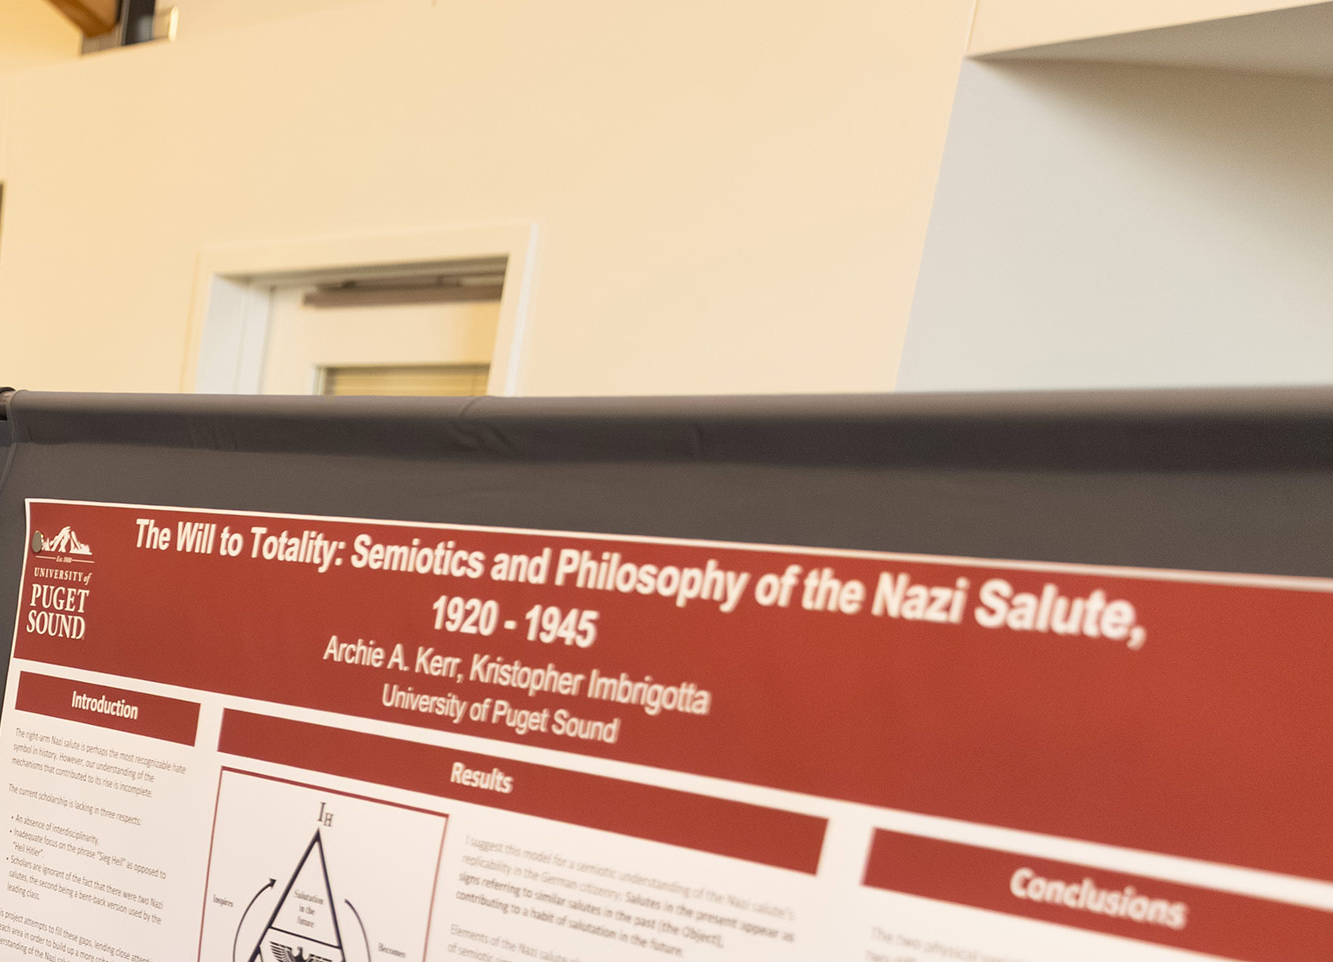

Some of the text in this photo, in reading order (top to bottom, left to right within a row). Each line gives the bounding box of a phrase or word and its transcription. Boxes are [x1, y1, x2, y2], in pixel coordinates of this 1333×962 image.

[34, 567, 92, 585] UNIVERSITY of
[135, 518, 1147, 652] The Will to Totality: Semiotics and Philosophy of the Nazi Salute,
[30, 584, 89, 613] PUGET
[26, 610, 85, 640] SOUND
[433, 595, 500, 637] 1920
[525, 603, 600, 648] 1945
[323, 635, 712, 716] Archie A. Kerr, Kristopher Imbrigotta
[71, 690, 139, 720] Introduction
[382, 683, 622, 744] University of Puget Sound
[450, 762, 514, 794] Results
[1009, 866, 1189, 930] Conclusions
